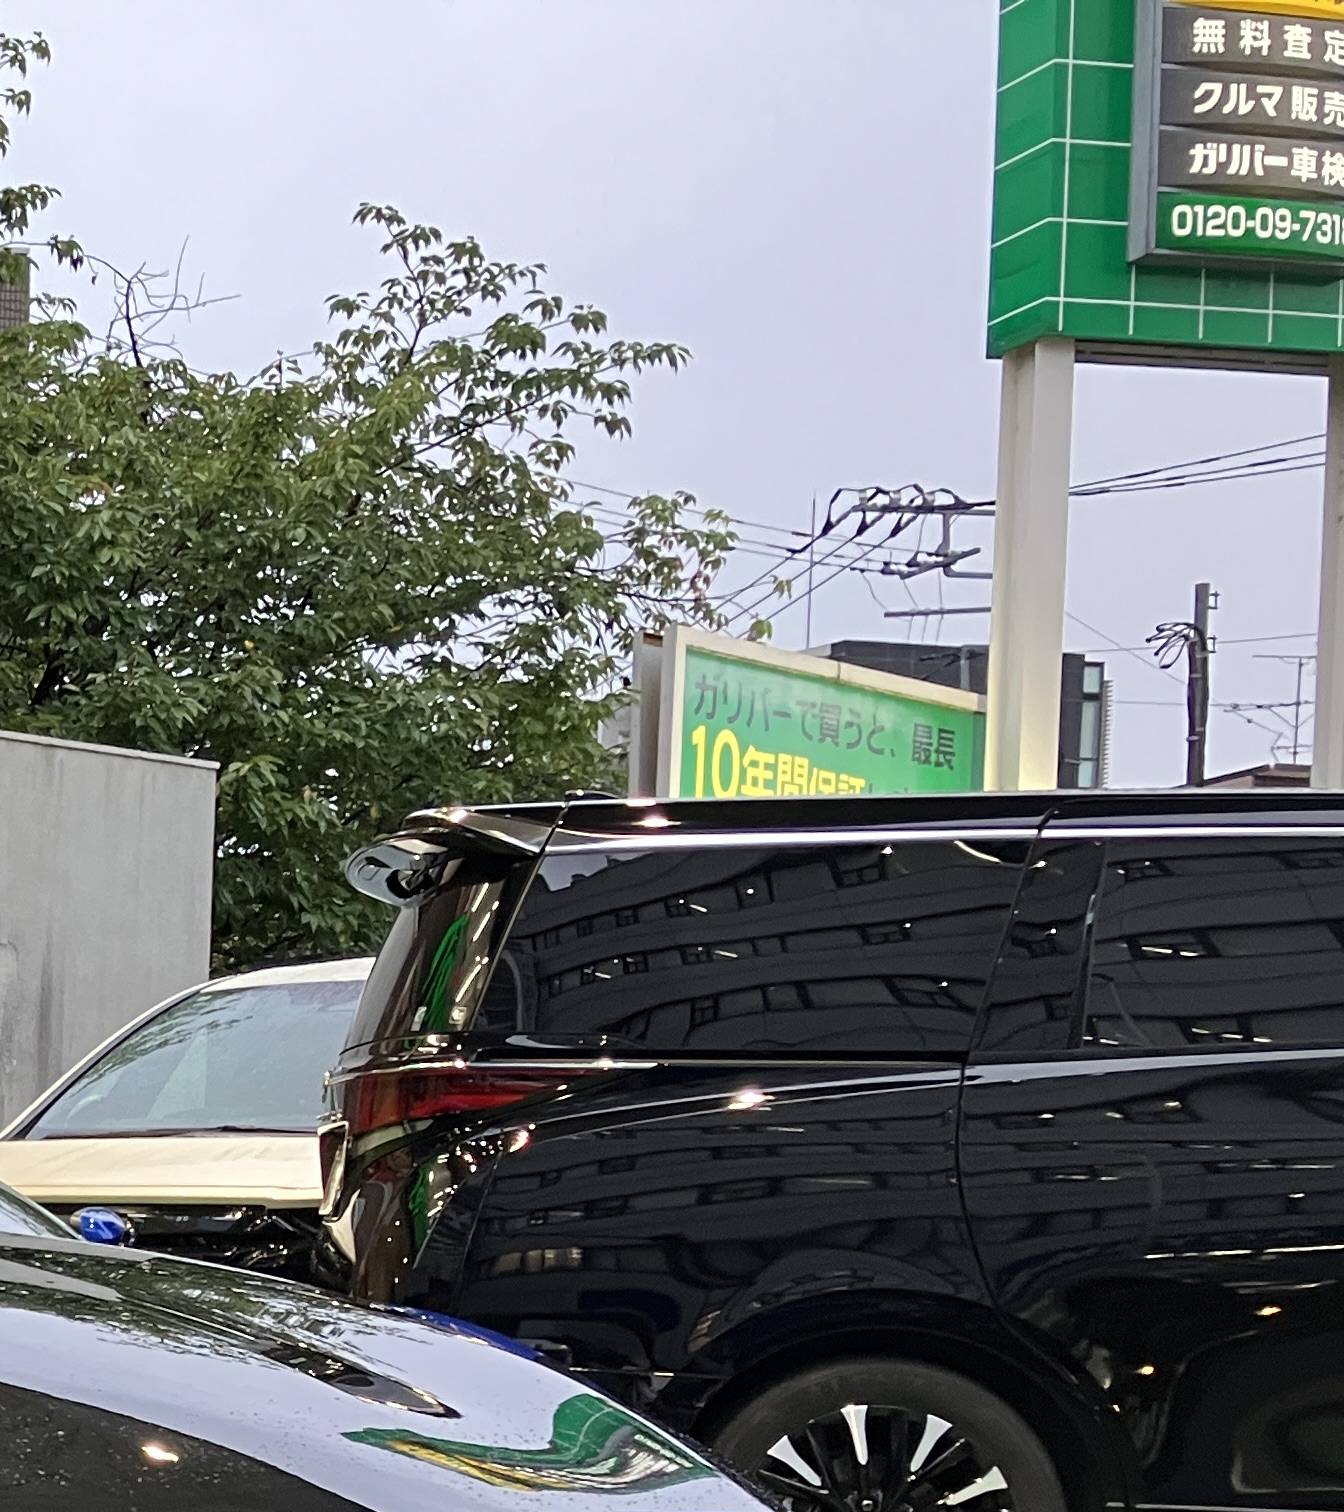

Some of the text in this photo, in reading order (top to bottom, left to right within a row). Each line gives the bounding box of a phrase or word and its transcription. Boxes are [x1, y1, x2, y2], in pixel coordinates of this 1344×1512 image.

[1192, 17, 1344, 67] 無料査定
[1193, 82, 1344, 127] クルマ販売
[1188, 142, 1344, 187] ガリバー車検
[1170, 204, 1344, 247] 0120-09-731
